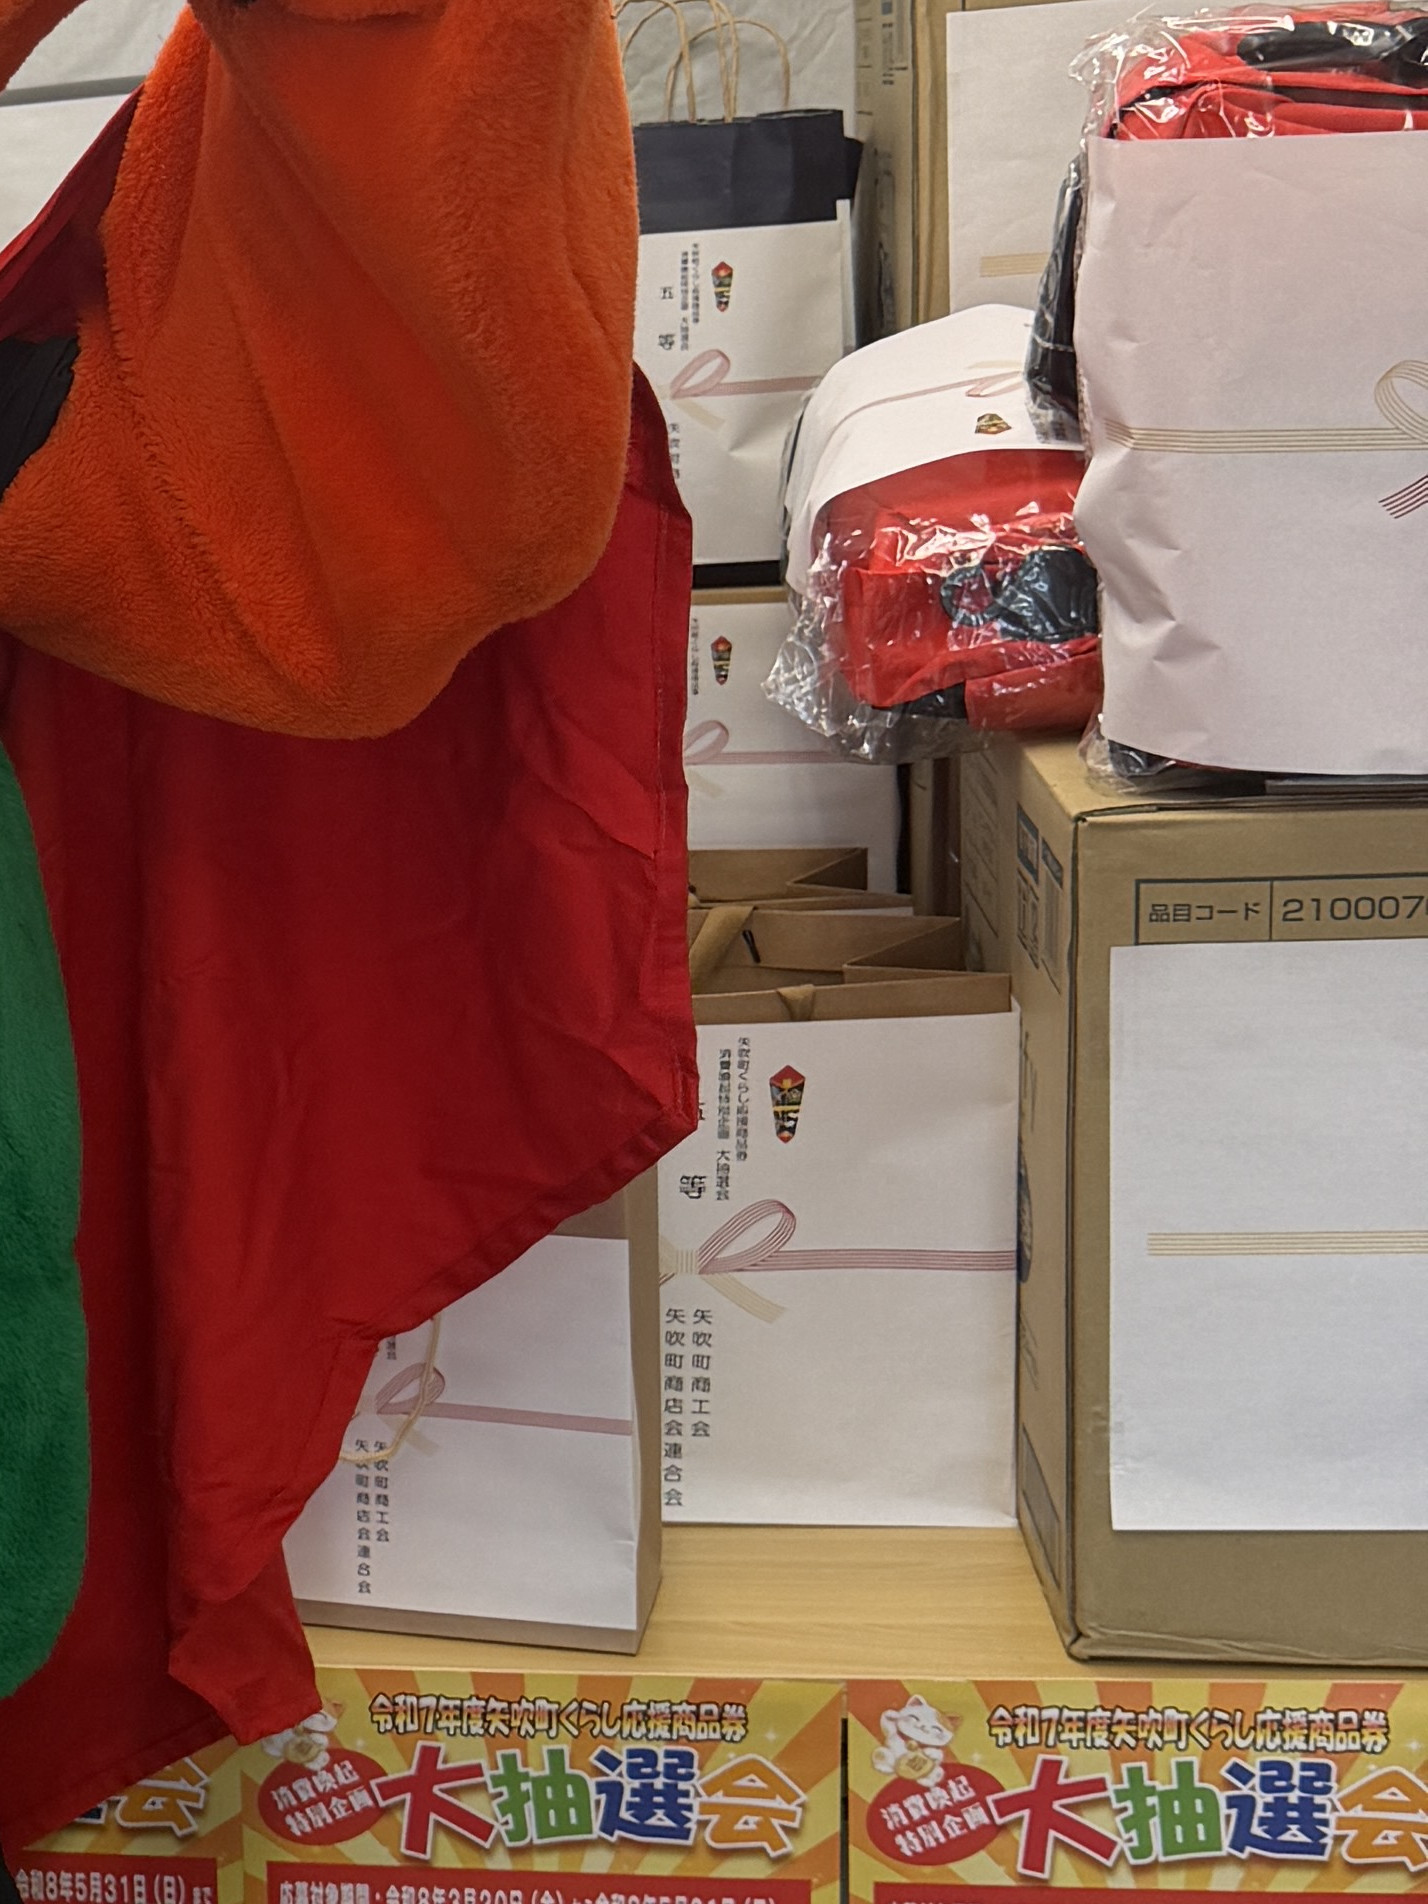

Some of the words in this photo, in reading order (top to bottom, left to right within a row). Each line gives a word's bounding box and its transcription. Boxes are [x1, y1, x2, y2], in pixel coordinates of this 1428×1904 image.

[1149, 902, 1261, 923] 品目コード
[1282, 895, 1428, 922] 210007
[664, 1309, 685, 1507] 矢吹町商店会連合会
[691, 1309, 712, 1437] 矢吹町商工会
[987, 1704, 1390, 1754] 令和7年度矢吹町くらし応援商品券
[370, 1739, 806, 1861] 大抽選会
[986, 1753, 1428, 1880] 大抽選会
